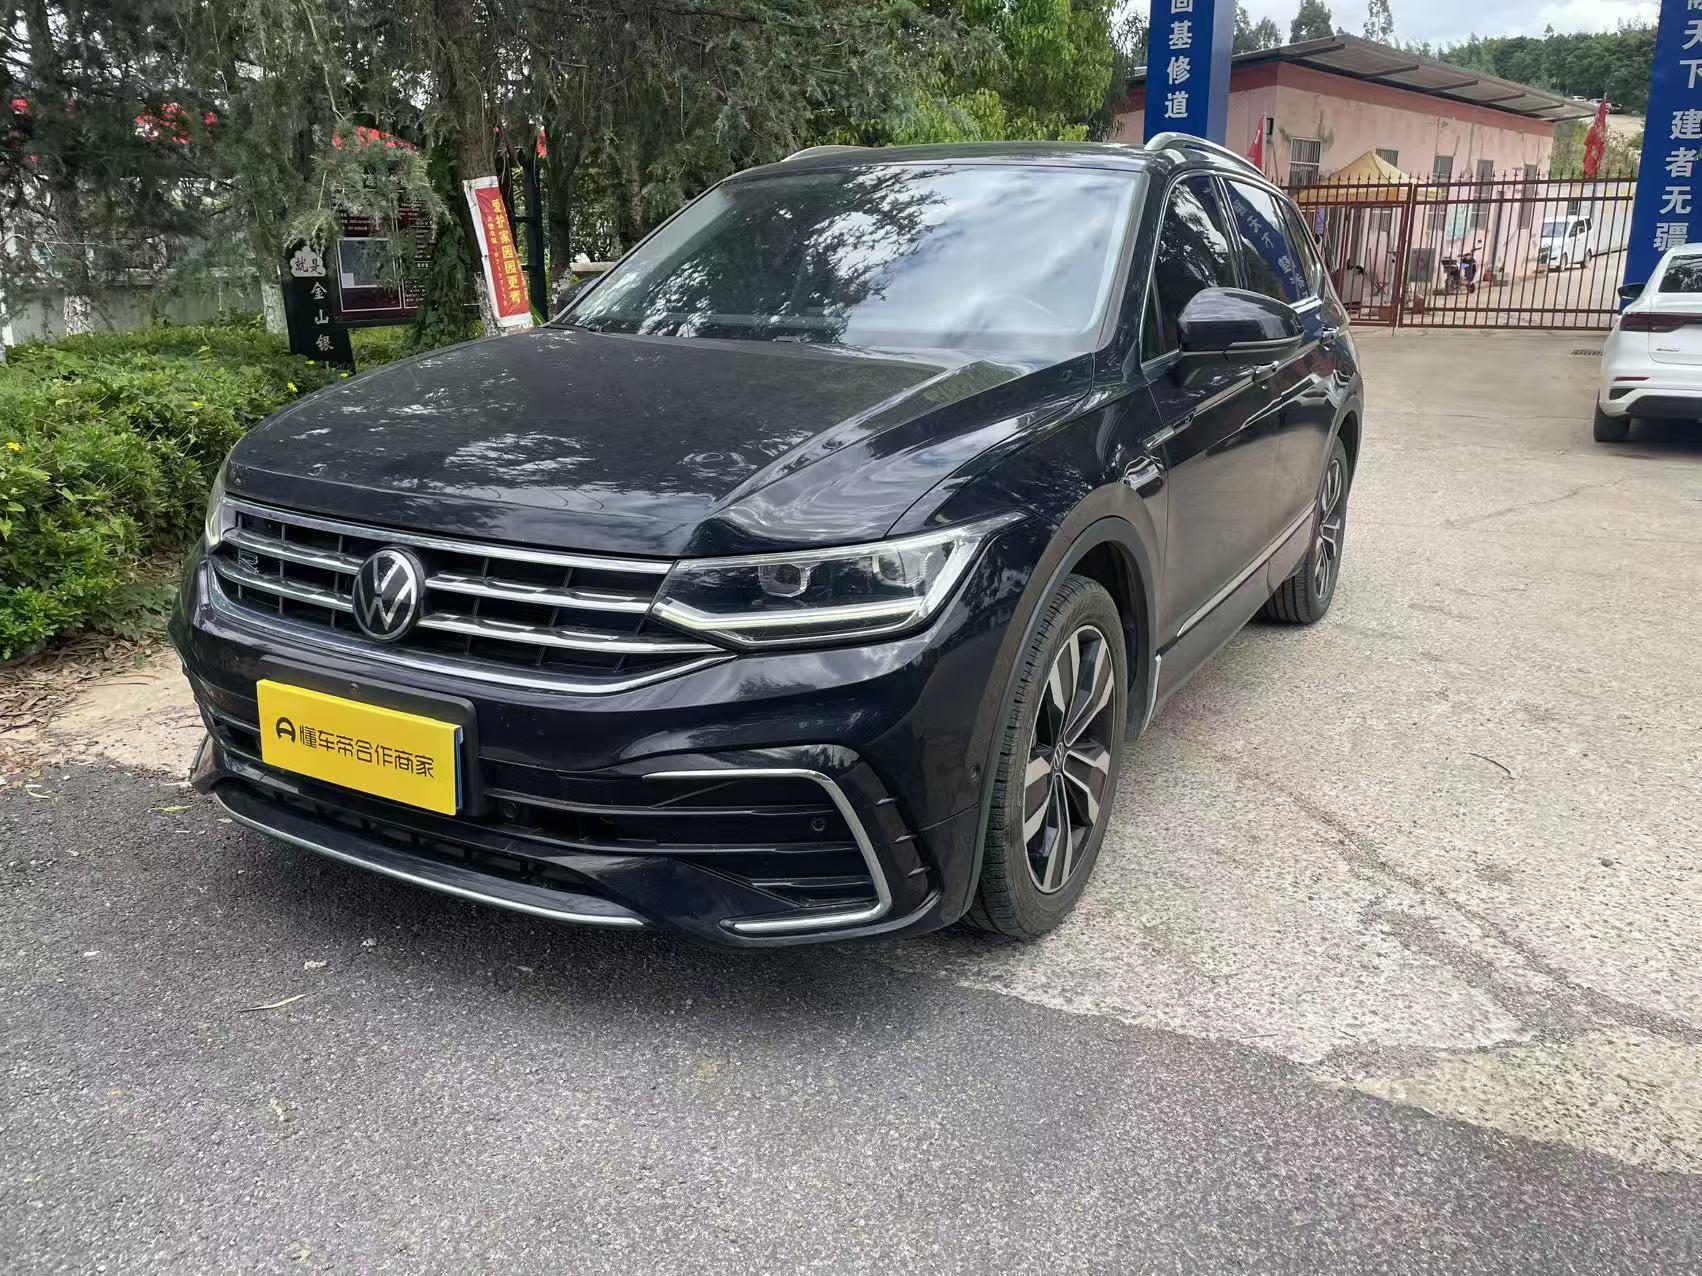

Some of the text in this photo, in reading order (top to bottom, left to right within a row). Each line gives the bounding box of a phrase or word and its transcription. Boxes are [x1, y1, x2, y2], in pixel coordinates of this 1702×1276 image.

[1653, 0, 1702, 252] 天下 建者无疆
[295, 257, 323, 275] 就是
[299, 724, 435, 779] 懂车帝合作商家
